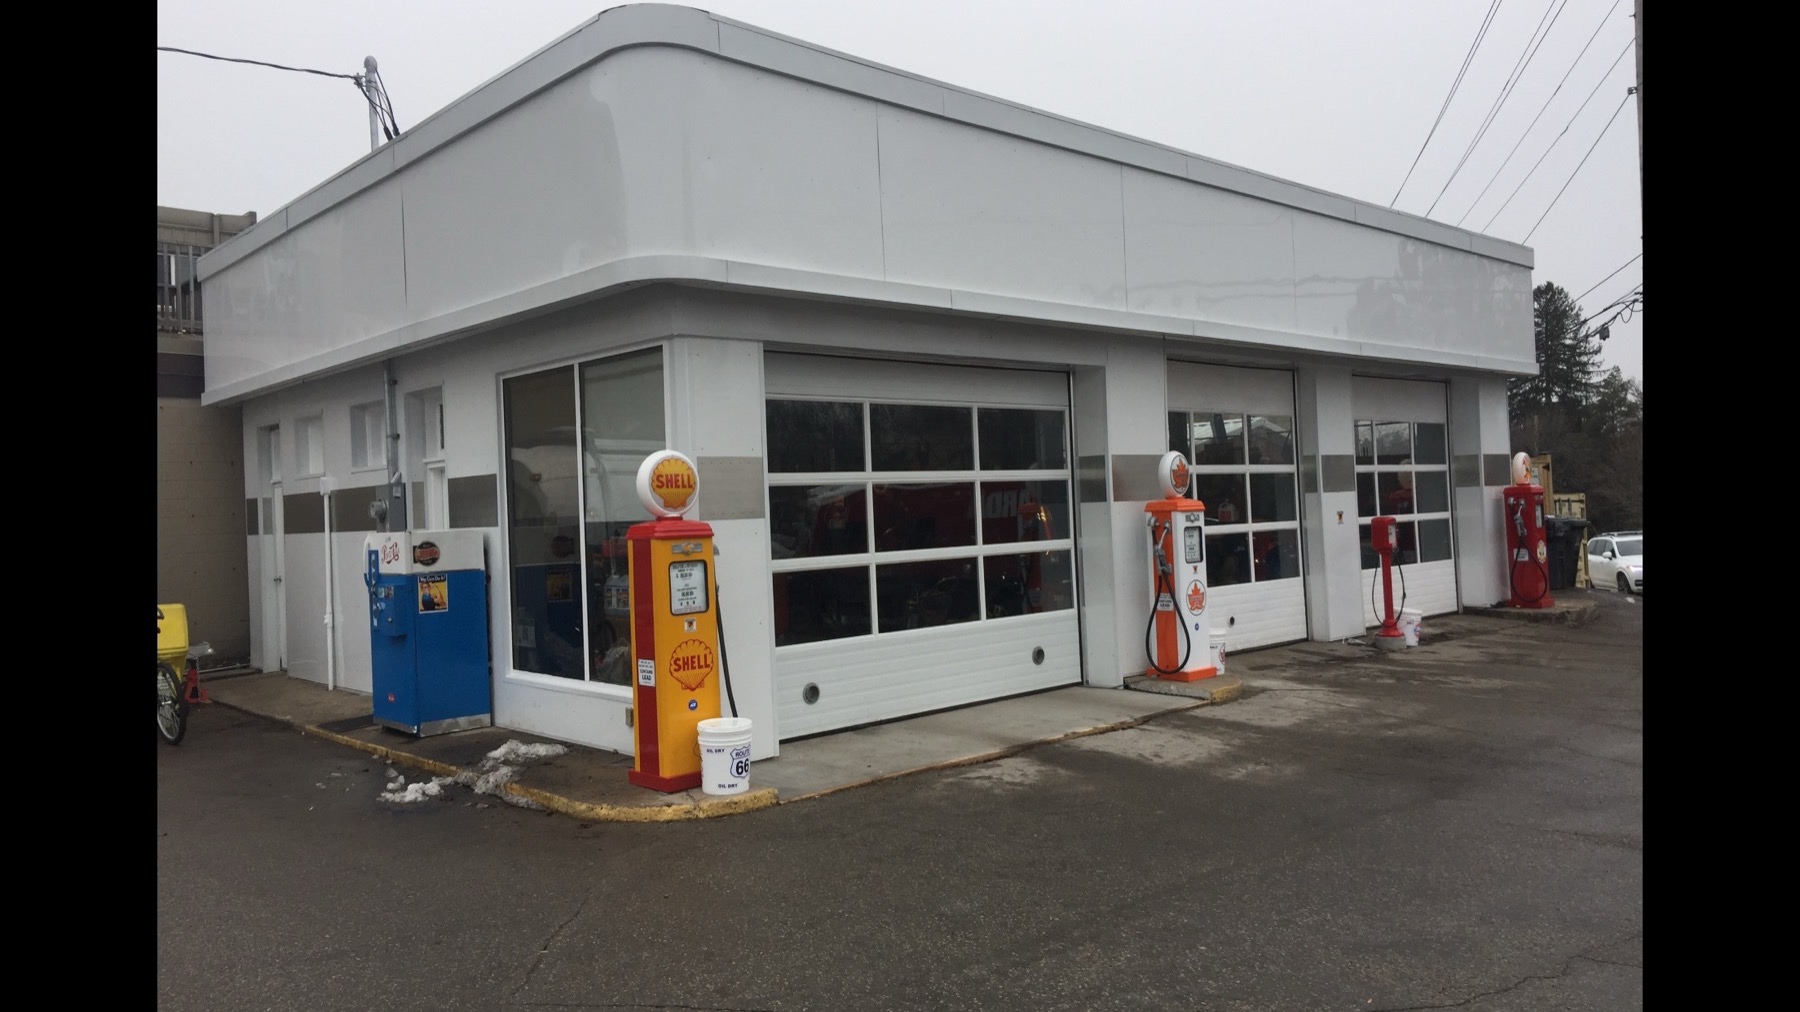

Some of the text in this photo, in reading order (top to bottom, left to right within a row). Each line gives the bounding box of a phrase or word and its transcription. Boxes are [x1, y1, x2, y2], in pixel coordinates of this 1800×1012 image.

[656, 473, 693, 489] SHELL
[673, 653, 711, 672] SHELL
[735, 758, 750, 775] 66
